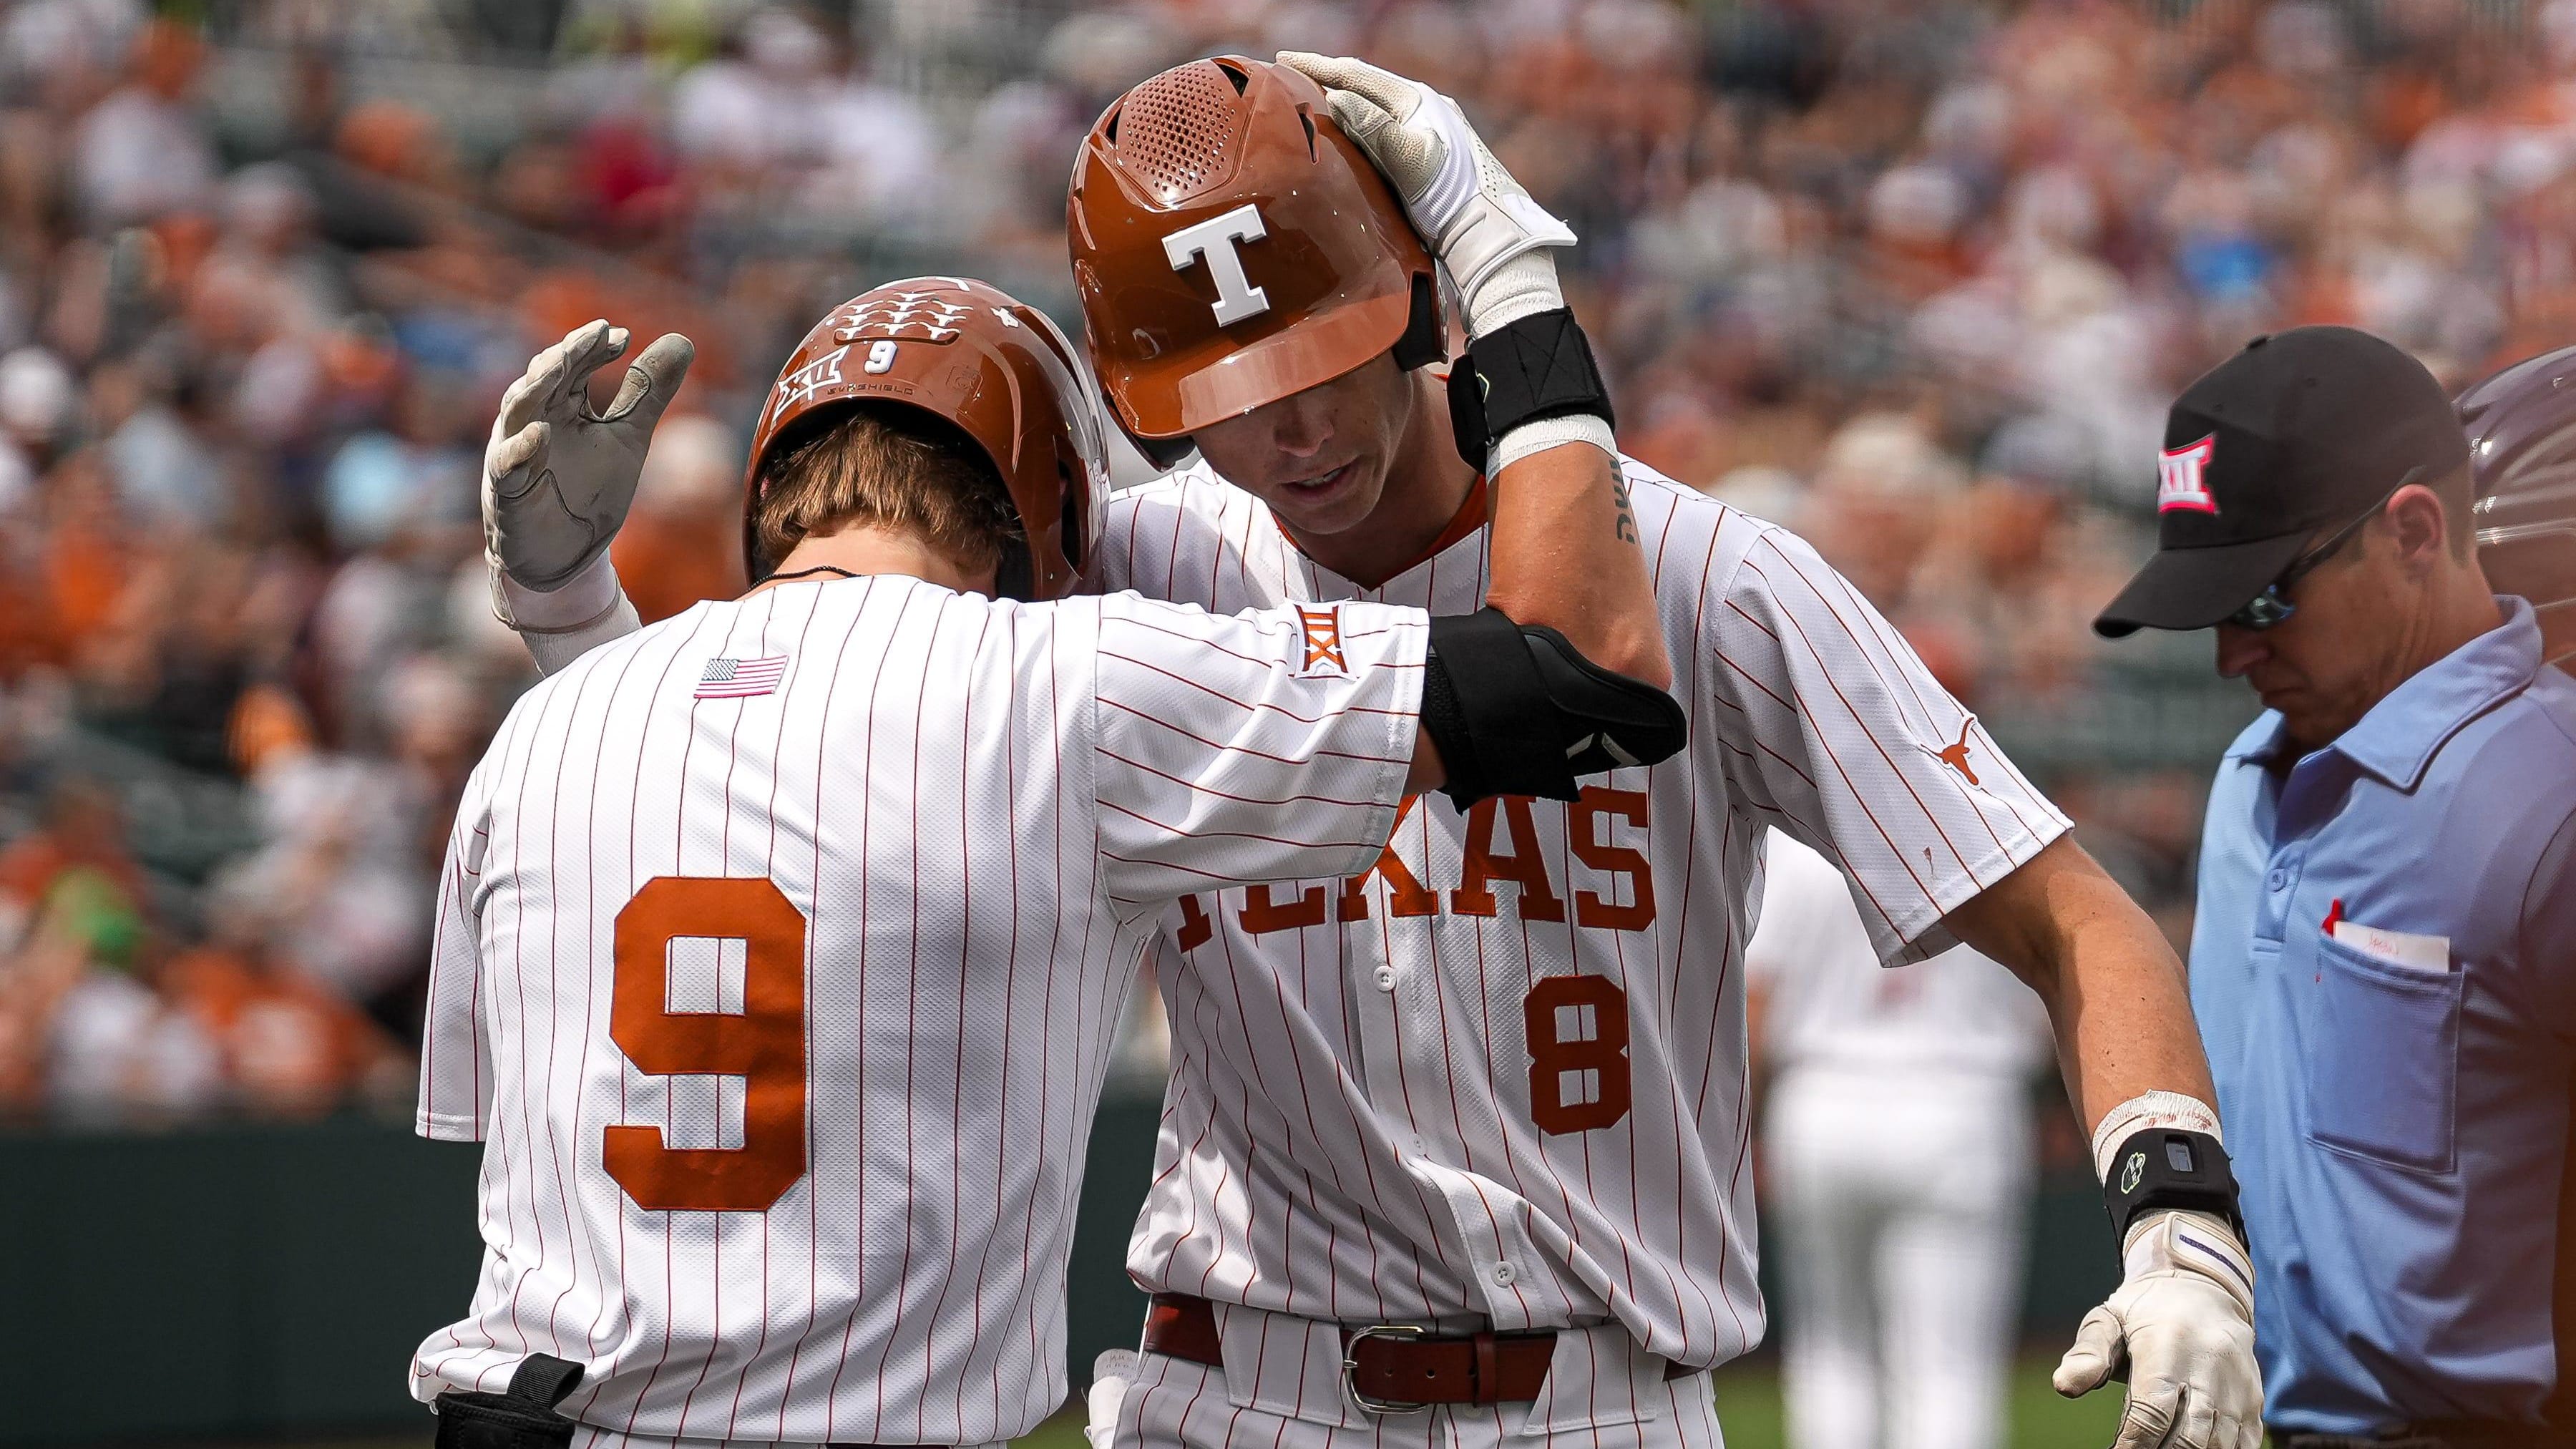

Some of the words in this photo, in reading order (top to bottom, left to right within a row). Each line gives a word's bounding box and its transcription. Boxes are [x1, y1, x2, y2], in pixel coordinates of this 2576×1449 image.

[1161, 204, 1269, 327] T
[864, 341, 897, 374] 9
[602, 875, 806, 1212] 9
[1523, 975, 1631, 1136] 8
